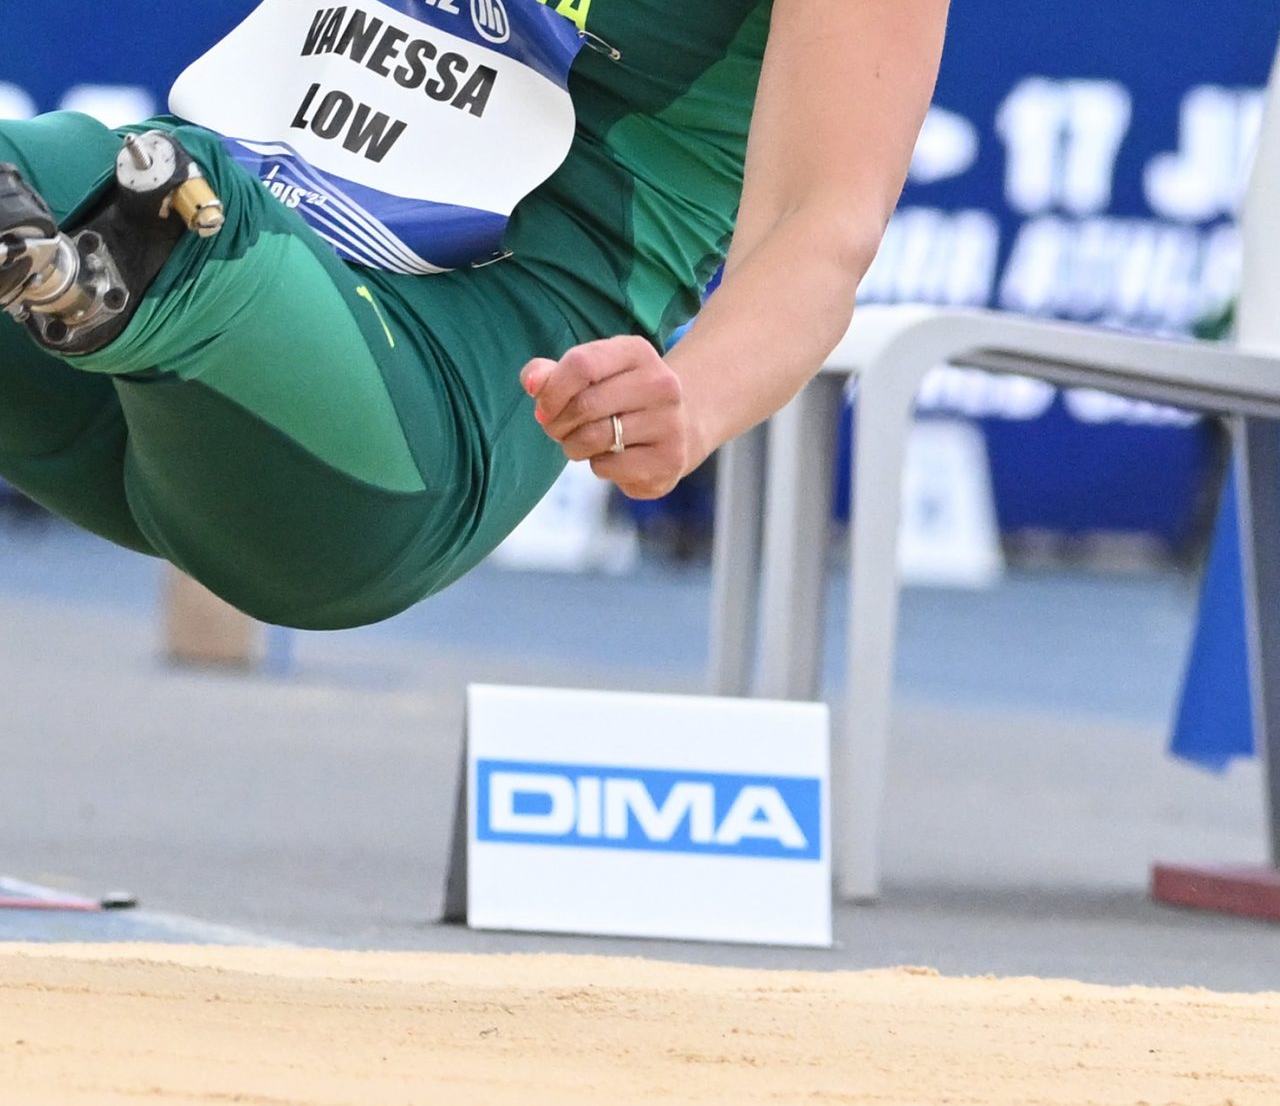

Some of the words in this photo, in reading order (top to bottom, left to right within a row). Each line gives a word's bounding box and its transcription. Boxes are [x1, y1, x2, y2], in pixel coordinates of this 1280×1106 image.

[301, 6, 498, 118] VANESSA
[290, 83, 408, 162] LOW
[488, 771, 808, 849] DIMA
